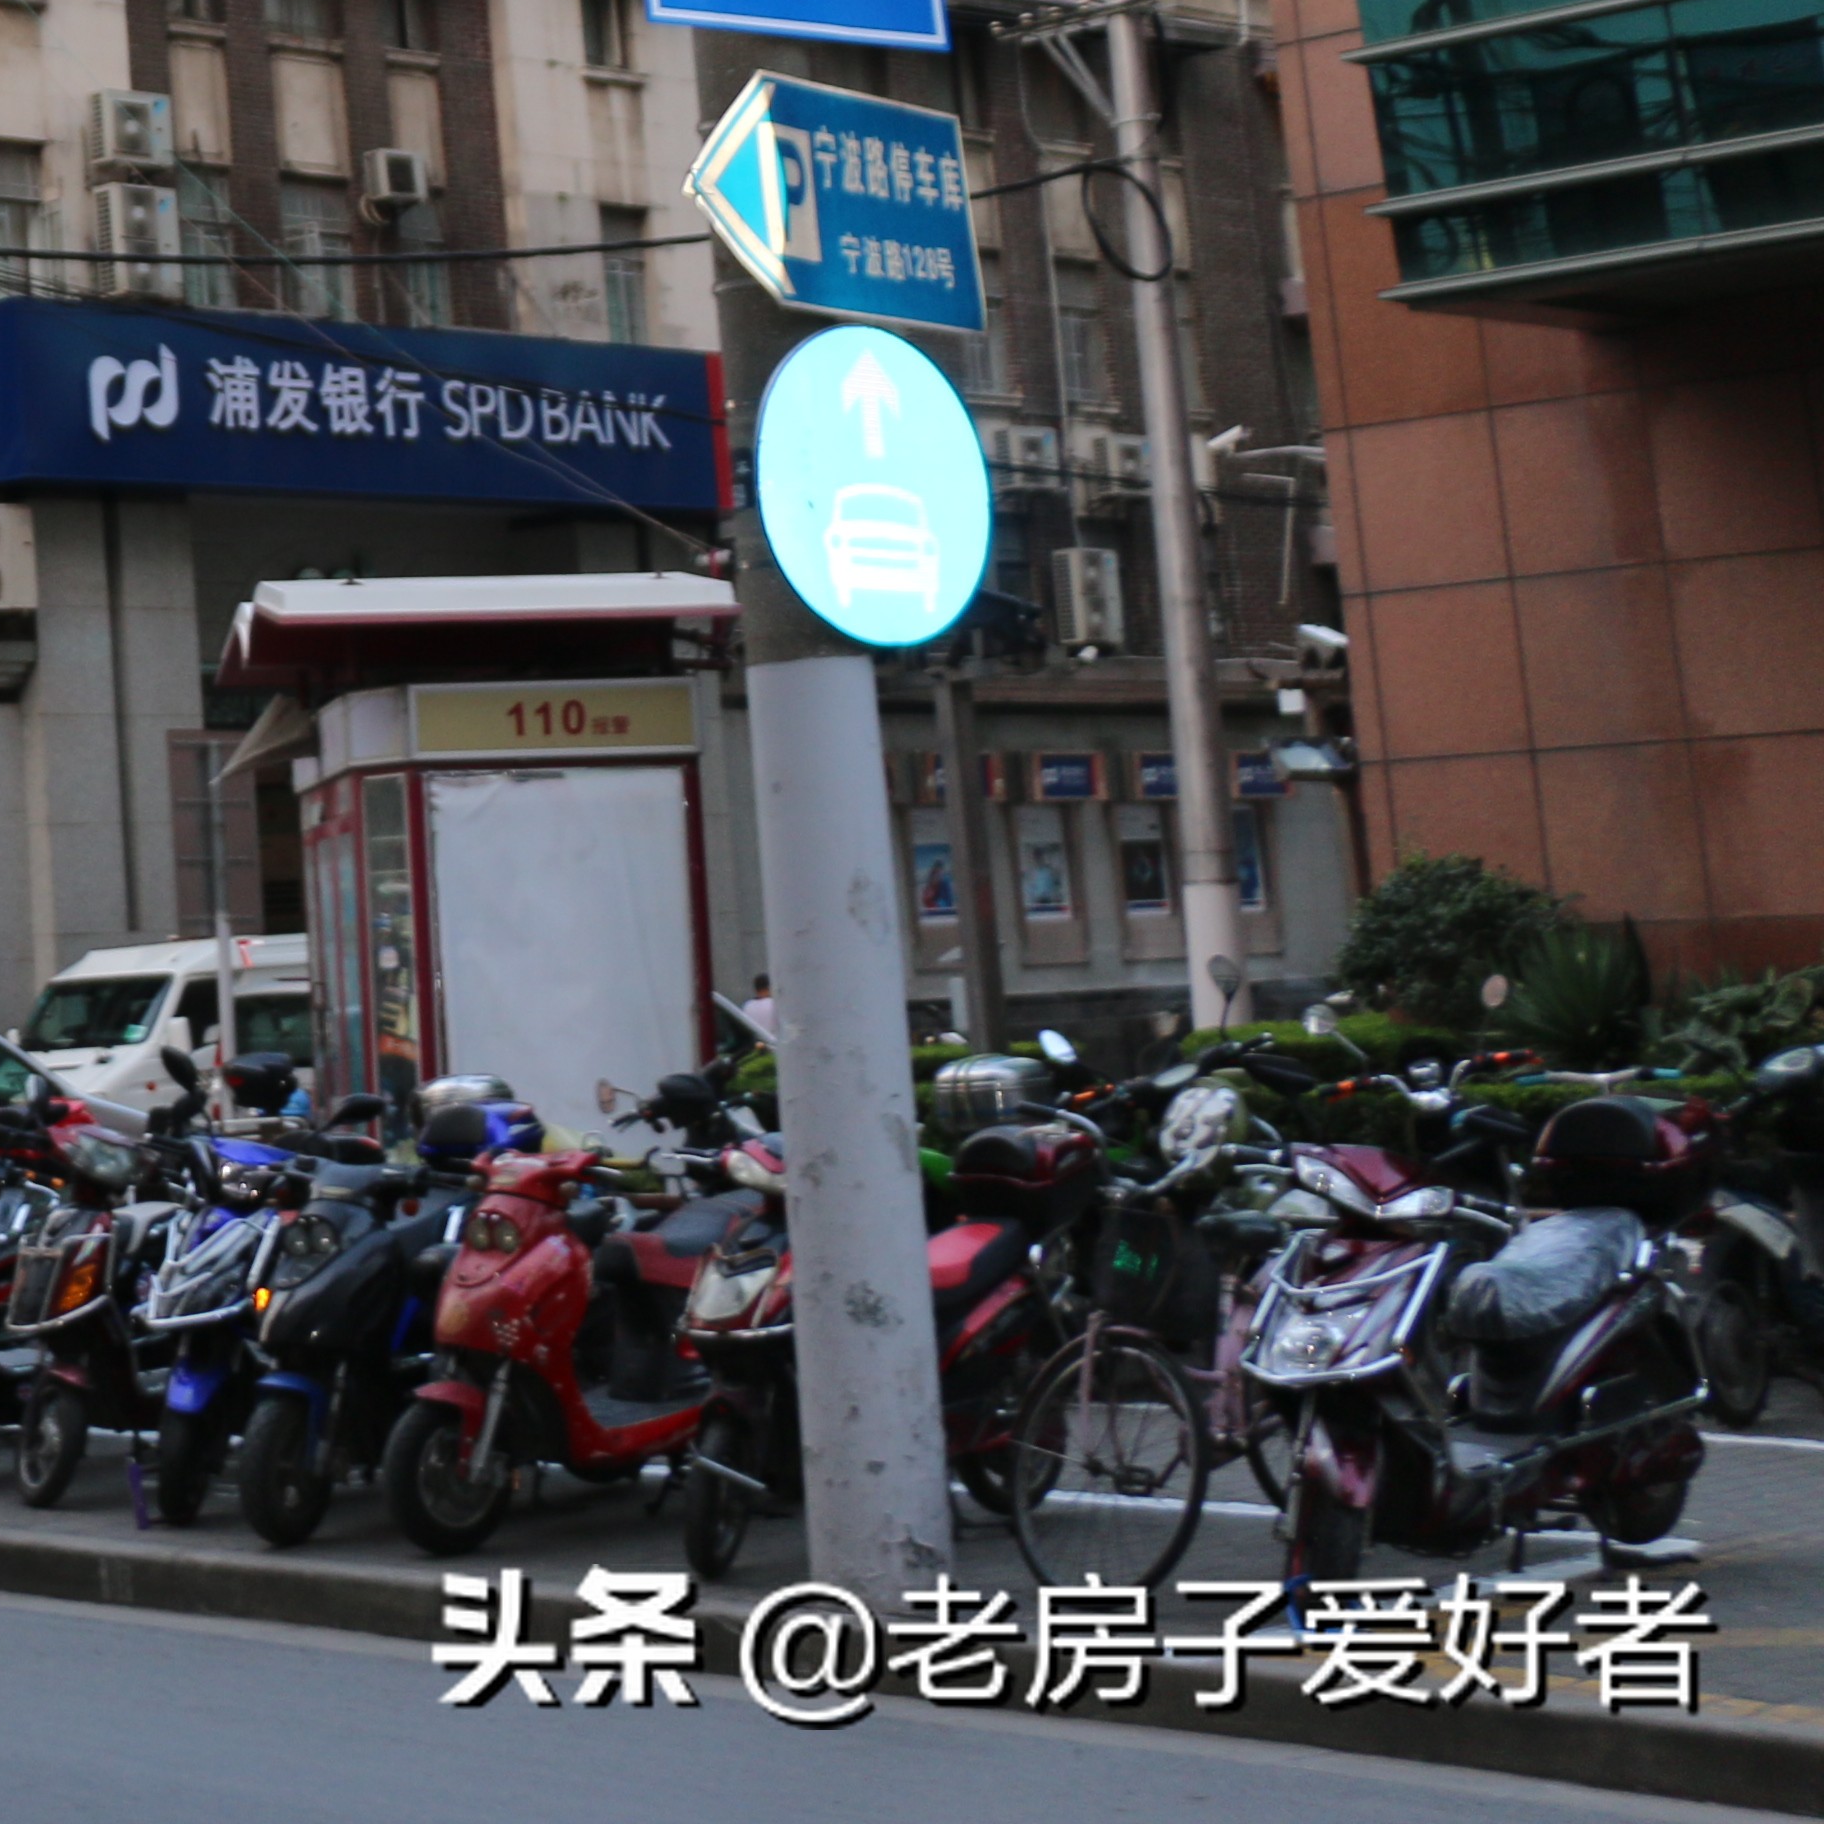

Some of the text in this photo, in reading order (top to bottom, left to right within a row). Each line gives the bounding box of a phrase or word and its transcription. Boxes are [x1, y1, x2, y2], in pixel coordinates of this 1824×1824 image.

[813, 126, 965, 211] 宁波路停车库
[206, 354, 672, 451] 浦发银行 SPD BANK
[507, 699, 586, 737] 110
